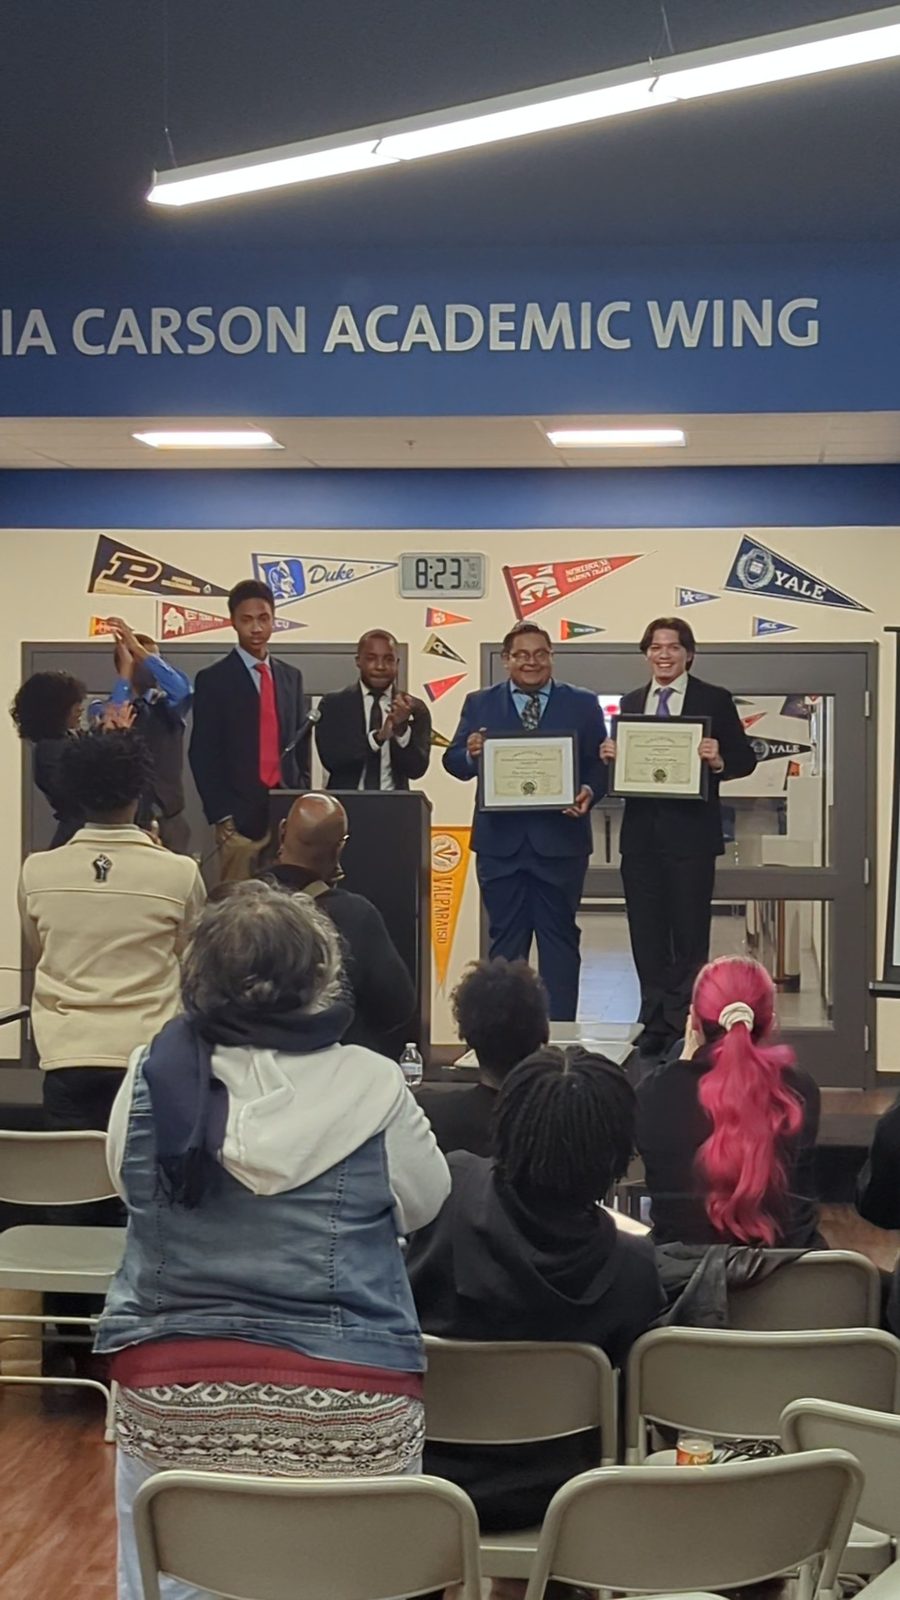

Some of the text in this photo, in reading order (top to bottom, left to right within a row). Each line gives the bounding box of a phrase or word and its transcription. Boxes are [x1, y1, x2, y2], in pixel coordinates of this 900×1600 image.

[1, 298, 819, 355] IA CARSON ACADEMIC WING
[307, 563, 355, 584] Duke
[415, 558, 462, 589] 8:23
[774, 569, 827, 600] YALE
[769, 744, 800, 754] YALE
[433, 876, 453, 944] VALPARAISO
